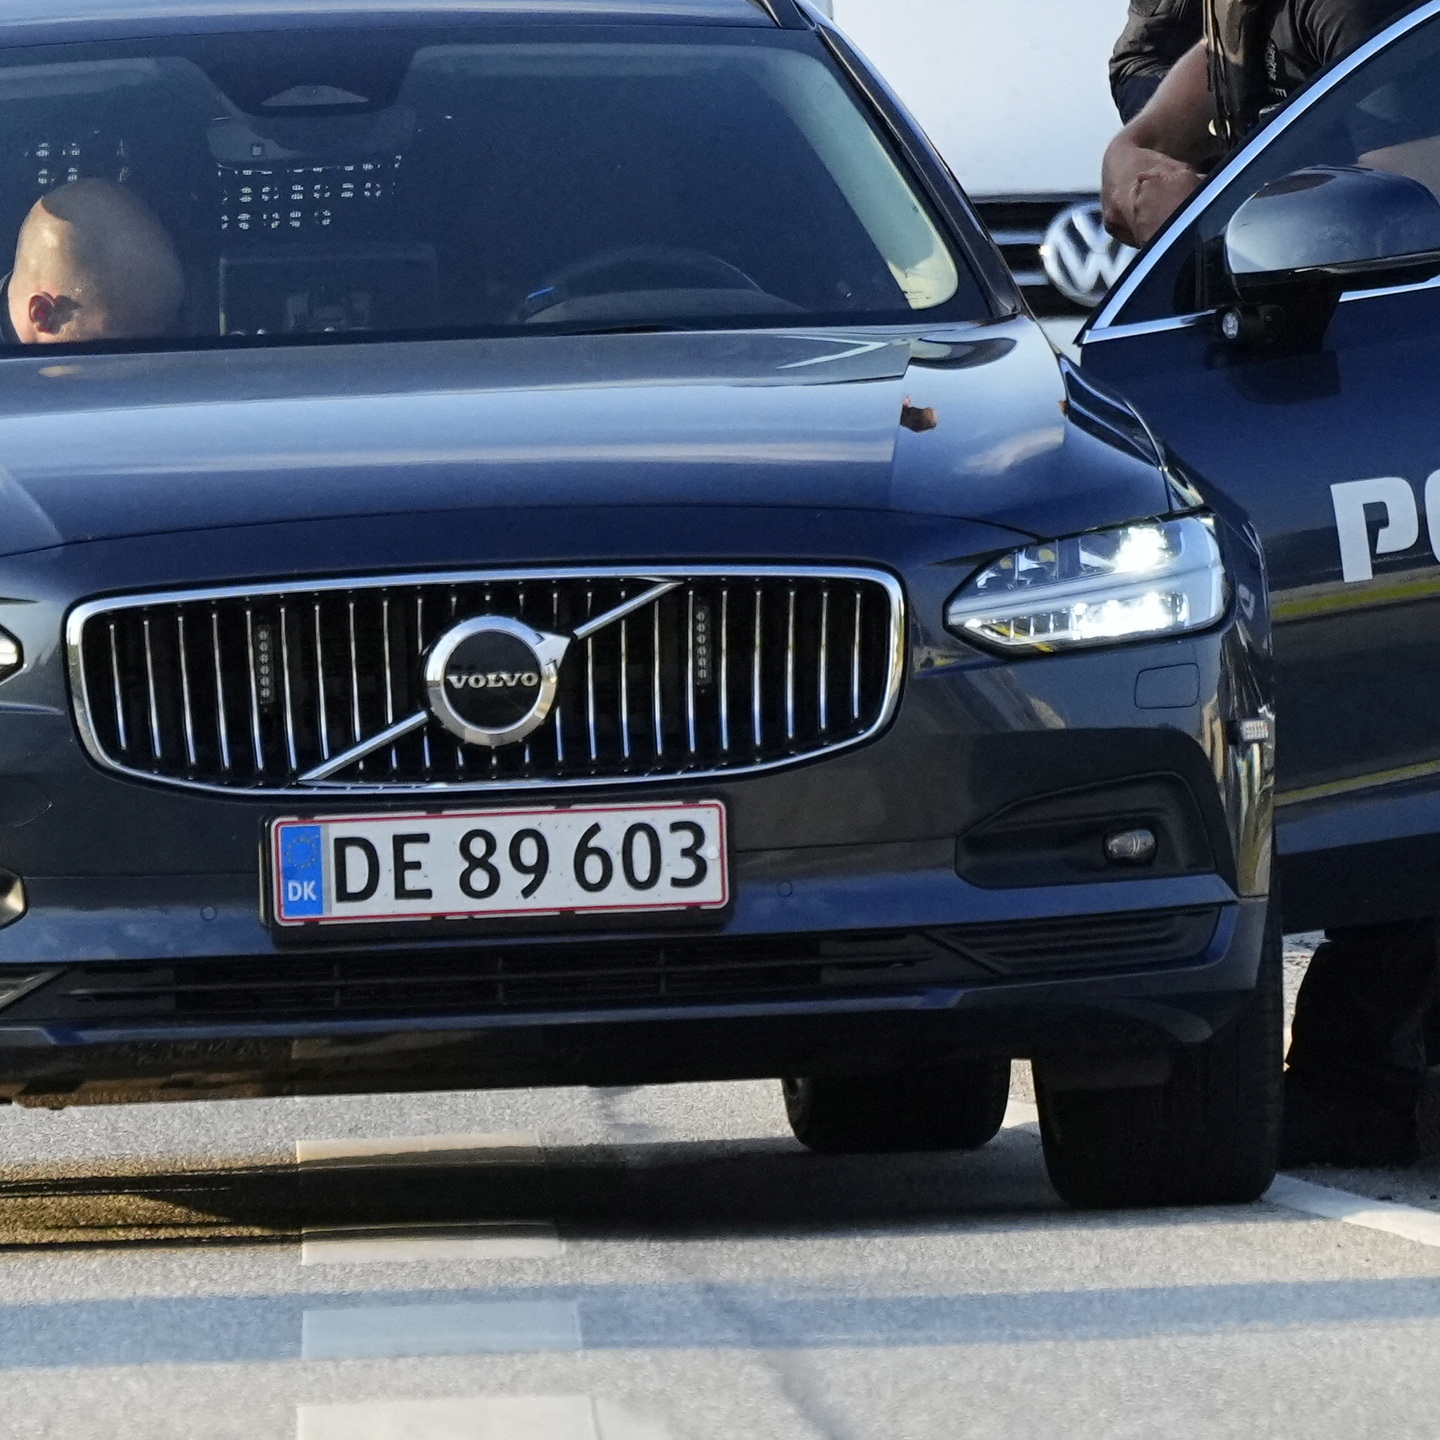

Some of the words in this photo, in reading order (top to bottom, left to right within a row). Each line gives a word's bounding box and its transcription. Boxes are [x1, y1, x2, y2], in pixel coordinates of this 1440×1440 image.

[445, 671, 539, 690] VOLVO
[332, 832, 433, 904] DE
[458, 827, 550, 900] 89
[572, 820, 709, 893] 603
[287, 879, 318, 902] DK
